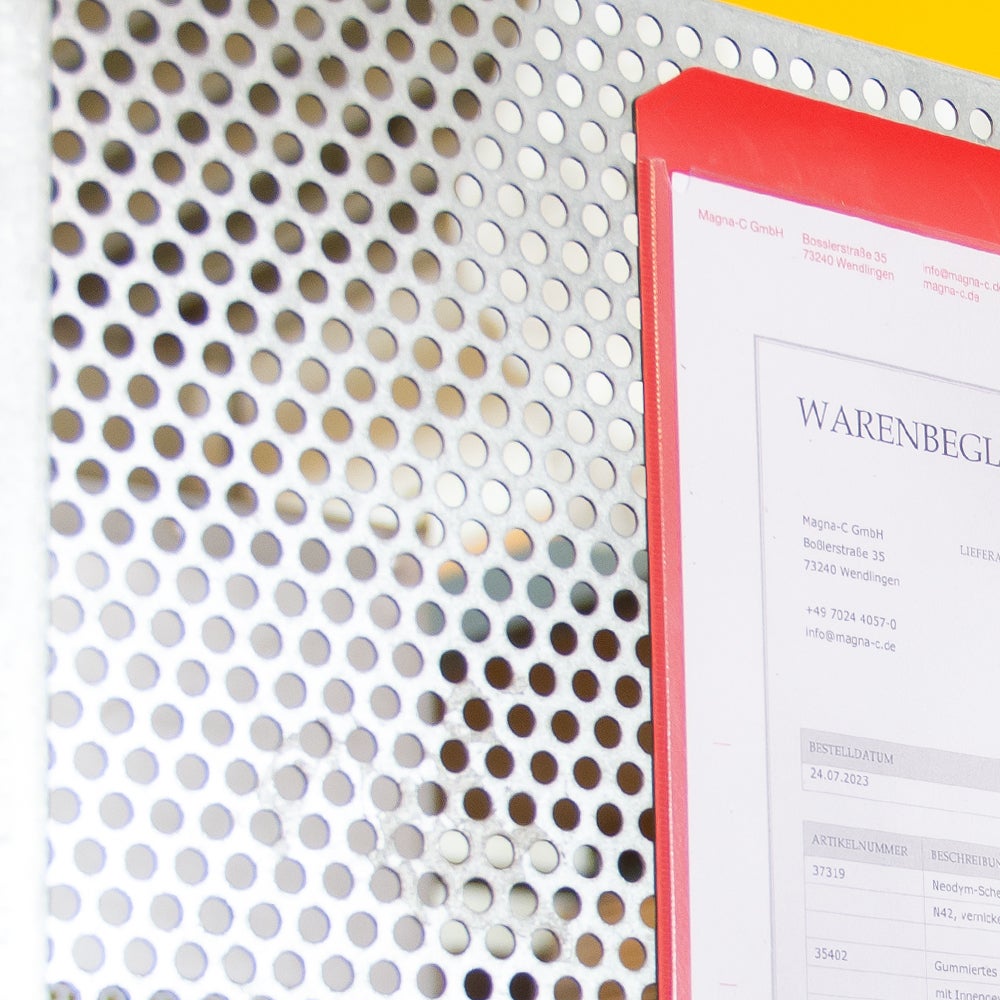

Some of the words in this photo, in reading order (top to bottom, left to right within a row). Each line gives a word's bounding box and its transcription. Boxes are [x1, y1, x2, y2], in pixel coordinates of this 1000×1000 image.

[698, 208, 747, 230] Magna-C
[750, 221, 784, 237] GmbH
[803, 249, 834, 265] 73240
[836, 258, 894, 281] Wendlingen
[874, 251, 887, 263] 35
[923, 279, 980, 302] magna-c.de
[803, 515, 848, 533] Magna-C
[852, 524, 883, 540] GmbH
[872, 551, 885, 562] 35
[804, 559, 836, 575] 73240
[840, 566, 900, 586] Wendlingen
[806, 605, 826, 618] +49
[831, 608, 856, 622] 7024
[860, 613, 896, 630] 4057-0
[806, 627, 896, 652] info@magna-c.de
[809, 741, 894, 765] BESTELLDATUM
[810, 768, 869, 787] 24.07.2023
[812, 834, 908, 857] ARTIKELNUMMER
[813, 865, 845, 879] 37319
[933, 906, 957, 920] N42,
[815, 948, 847, 962] 35402
[935, 961, 997, 977] Gummiertes
[936, 989, 952, 1000] mit
